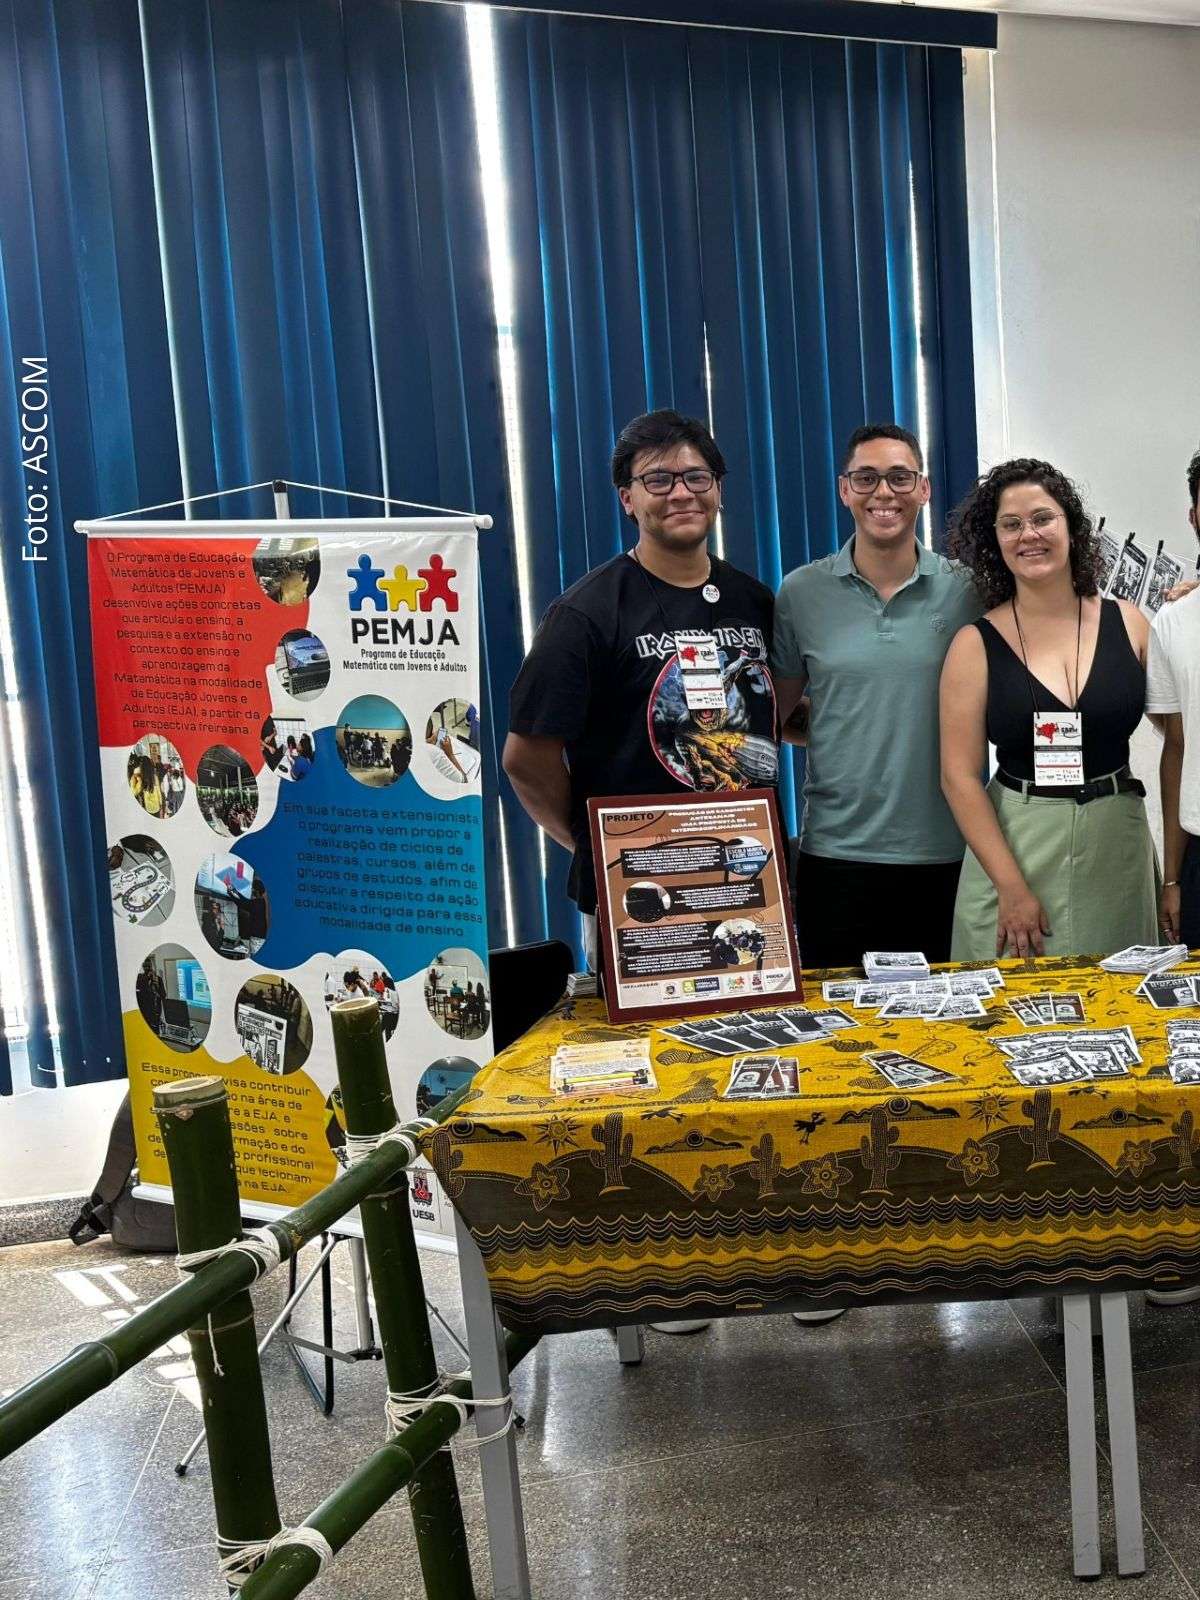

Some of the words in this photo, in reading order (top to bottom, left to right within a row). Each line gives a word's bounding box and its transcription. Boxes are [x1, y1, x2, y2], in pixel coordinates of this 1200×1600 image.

[351, 617, 460, 646] PEMJA
[361, 648, 396, 660] Programa
[398, 649, 407, 659] de
[409, 649, 446, 661] Educação
[343, 660, 387, 670] Matemática
[389, 662, 405, 670] com
[407, 661, 432, 671] Jovens
[433, 663, 438, 671] e
[440, 662, 467, 672] Adultos
[606, 812, 655, 823] PROJETO
[141, 1062, 171, 1075] Essa
[226, 1078, 247, 1088] visa
[249, 1081, 312, 1096] contribuir
[240, 1094, 255, 1103] na
[257, 1094, 285, 1108] área
[287, 1100, 302, 1111] de
[243, 1108, 250, 1117] a
[283, 1115, 290, 1123] e
[273, 1127, 308, 1140] sobre
[280, 1143, 288, 1152] e
[290, 1144, 306, 1154] do
[243, 1151, 314, 1170] profissional
[237, 1164, 255, 1175] que
[258, 1167, 311, 1184] lecionam
[244, 1180, 259, 1189] na
[412, 1209, 435, 1221] UESB
